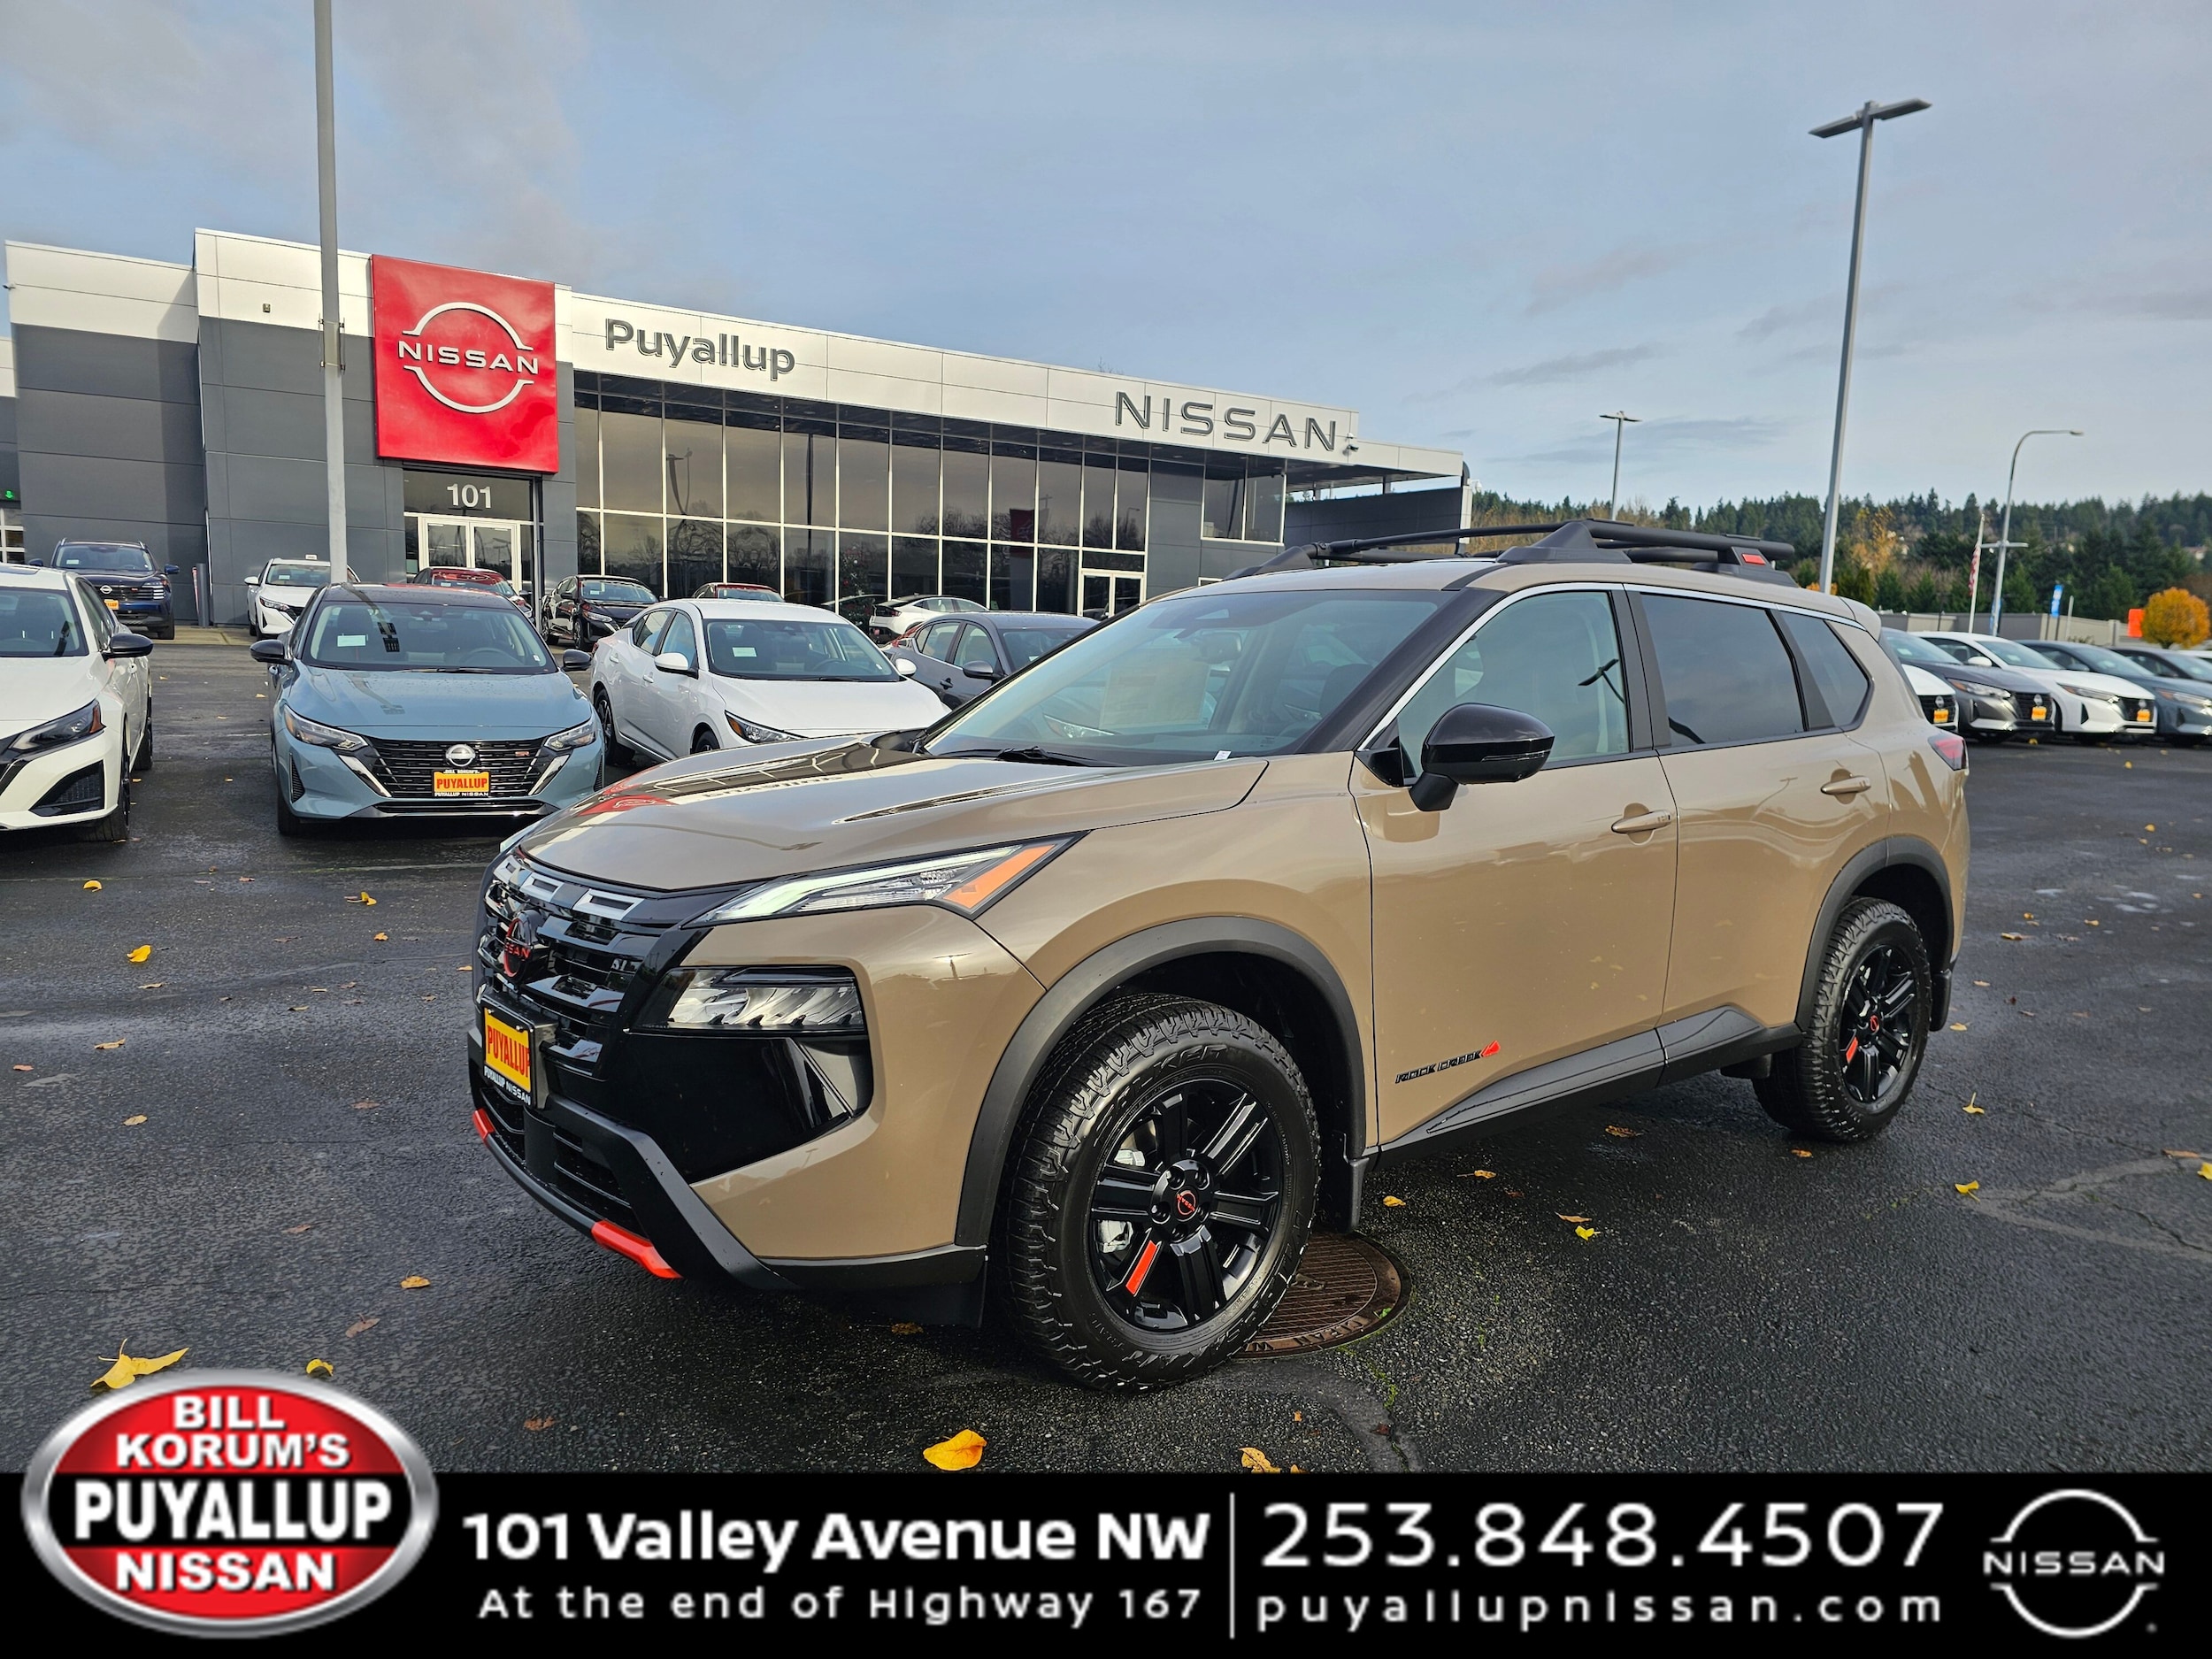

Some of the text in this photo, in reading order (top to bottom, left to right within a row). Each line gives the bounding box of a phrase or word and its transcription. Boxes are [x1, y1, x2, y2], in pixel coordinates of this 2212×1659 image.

[397, 339, 539, 375] NISSAN
[605, 318, 796, 382] Puyallup
[1115, 391, 1337, 451] NISSAN
[447, 483, 492, 510] 101
[436, 778, 488, 789] PUYALLUP
[487, 1025, 531, 1078] PUYALLUP
[1394, 1049, 1482, 1084] ROCK CREEK
[505, 1080, 531, 1106] NISSAN
